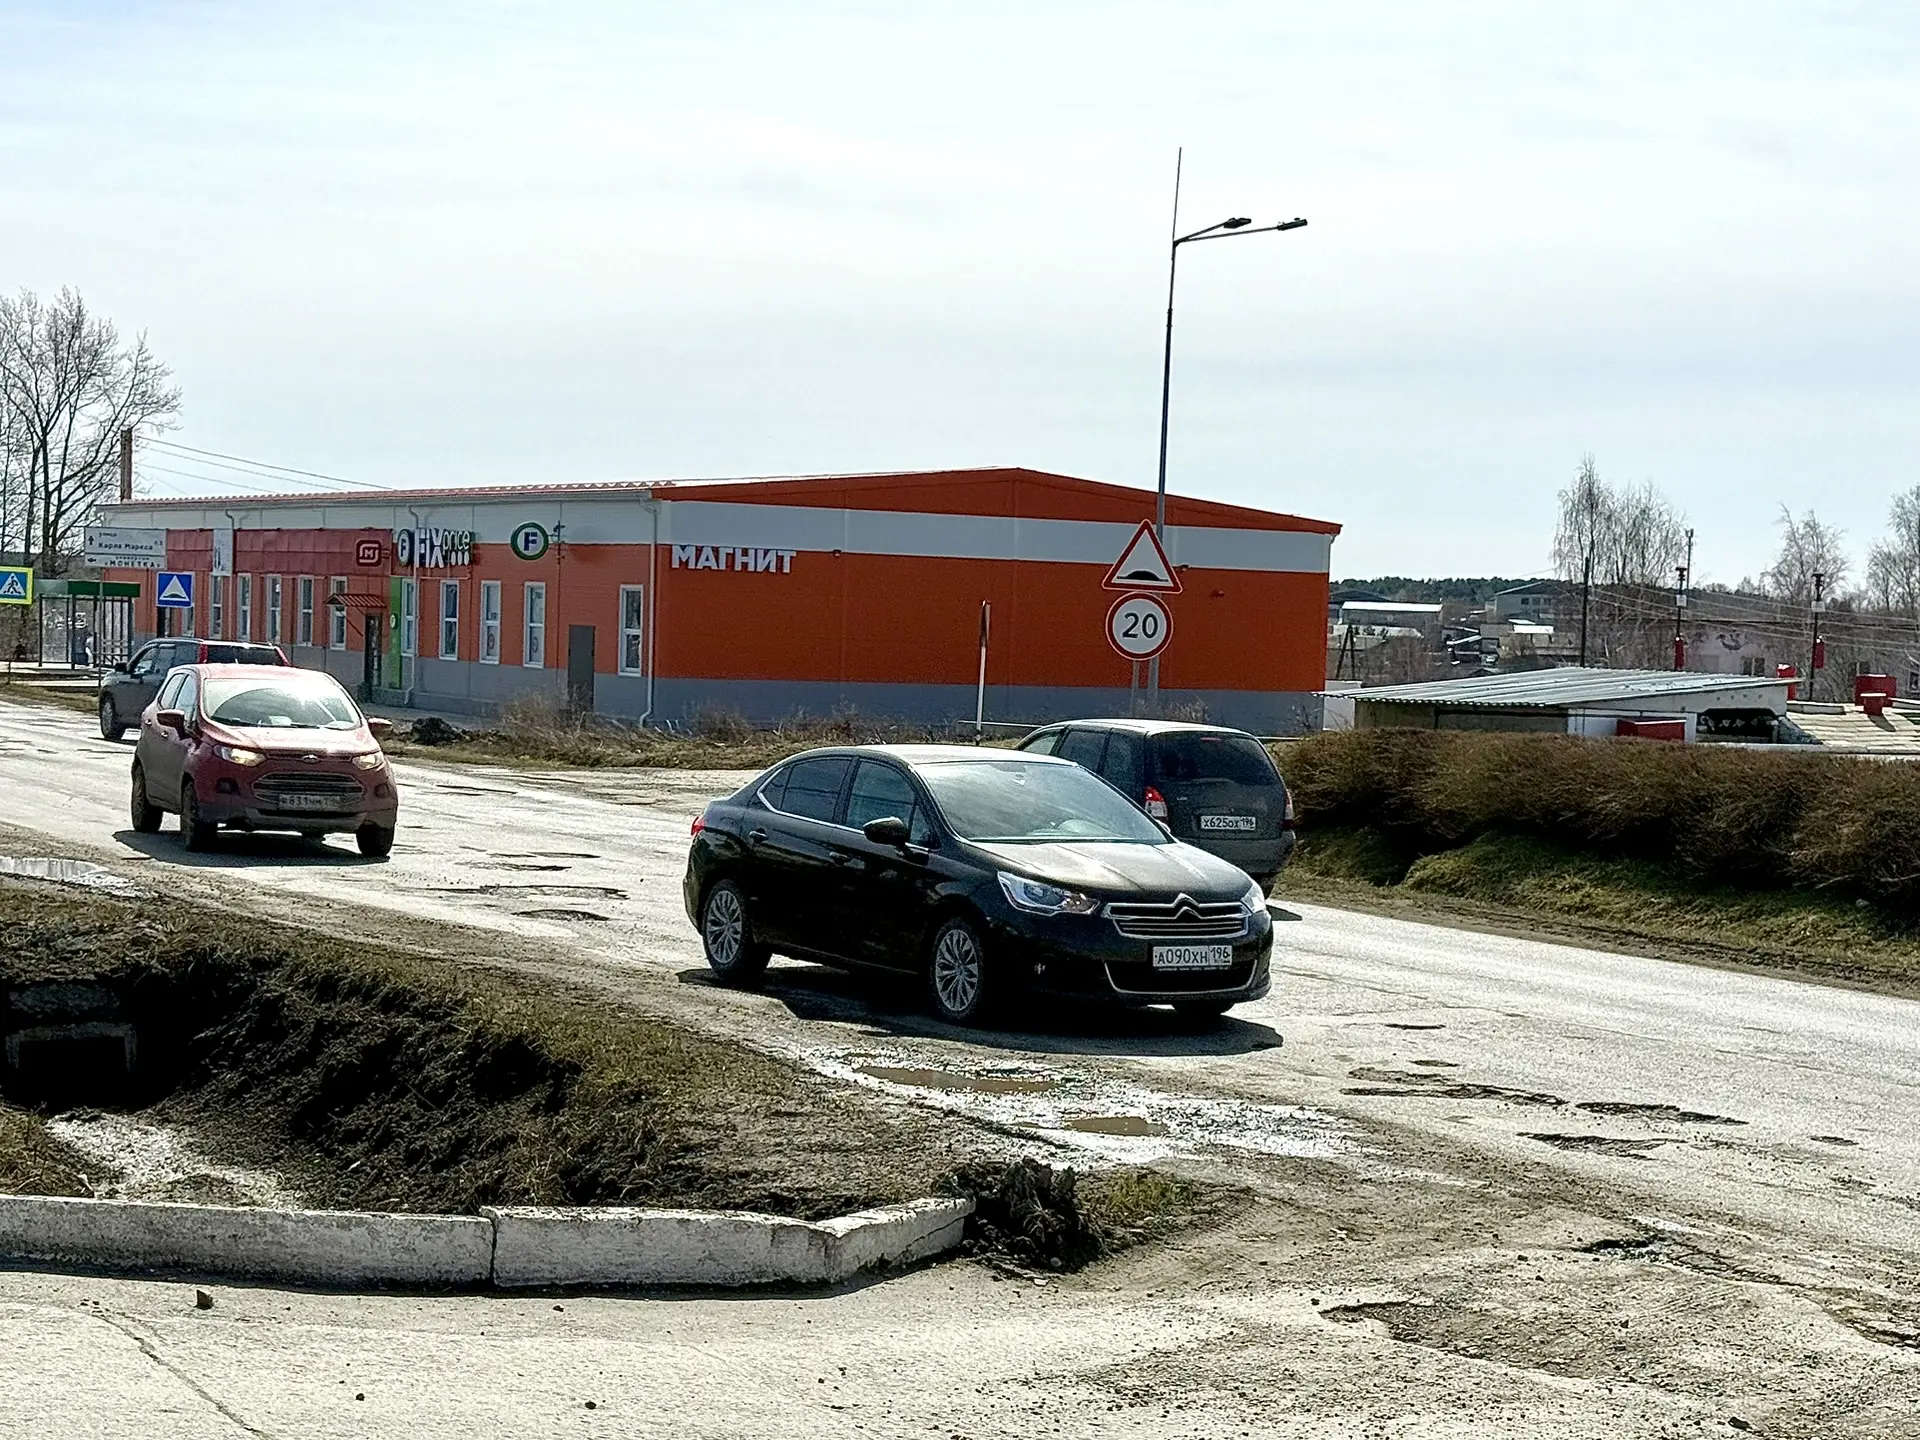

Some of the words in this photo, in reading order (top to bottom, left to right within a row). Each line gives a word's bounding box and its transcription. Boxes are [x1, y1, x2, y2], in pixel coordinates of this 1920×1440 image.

[443, 530, 470, 555] price
[524, 532, 538, 551] F
[671, 545, 797, 573] МАГНИТ
[1122, 612, 1158, 638] 20
[1157, 948, 1208, 964] А090ХН
[1210, 947, 1228, 959] 196
